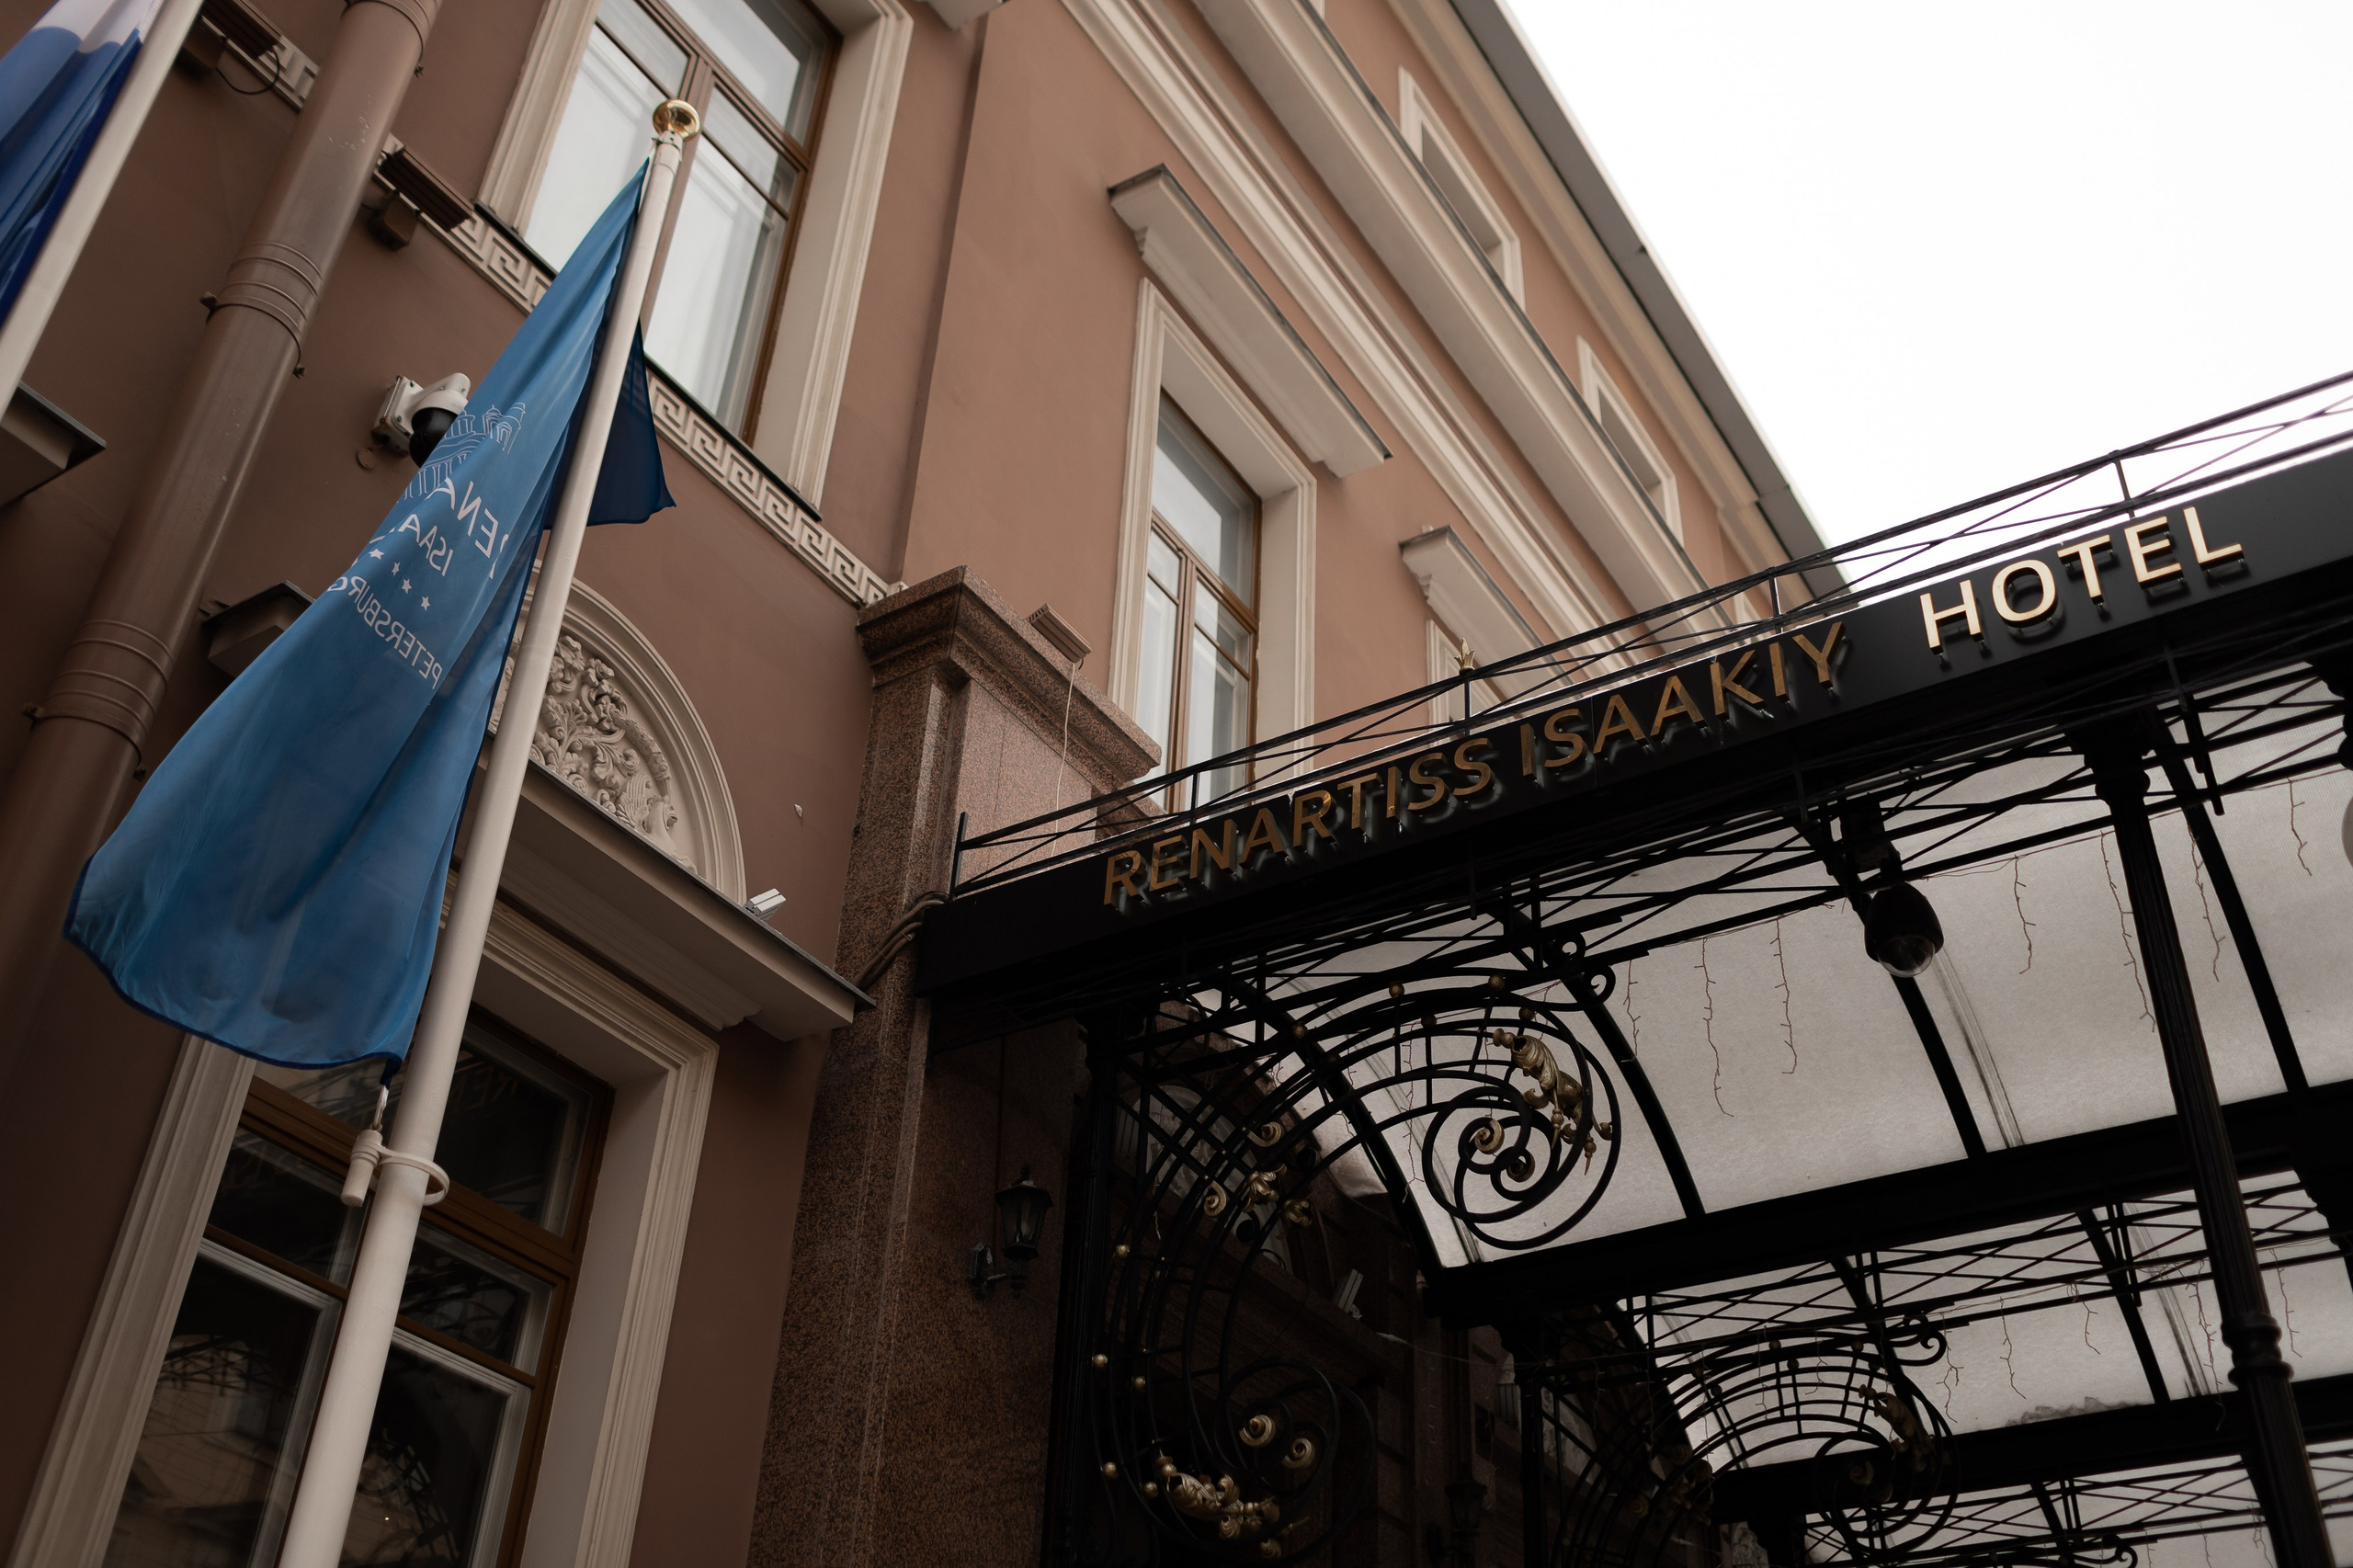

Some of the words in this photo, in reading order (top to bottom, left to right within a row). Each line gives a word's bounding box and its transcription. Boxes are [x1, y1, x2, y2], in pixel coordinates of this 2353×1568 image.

[1103, 737, 1495, 909] RENARTISS
[1520, 621, 1844, 779] ISAAKIY
[1920, 506, 2244, 653] HOTEL
